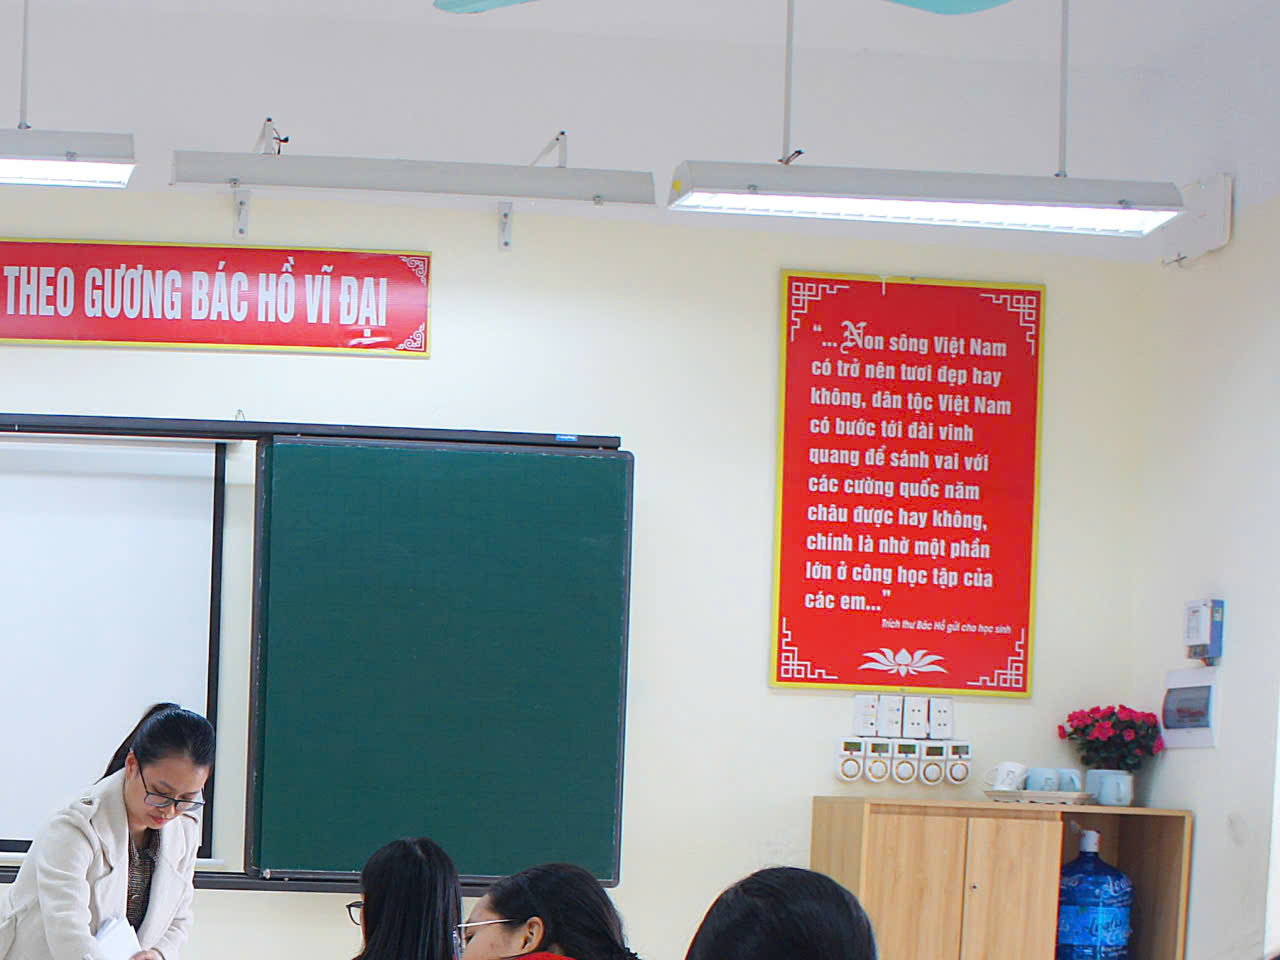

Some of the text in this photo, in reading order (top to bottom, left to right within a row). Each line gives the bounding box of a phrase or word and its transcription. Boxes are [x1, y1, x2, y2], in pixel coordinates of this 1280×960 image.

[3, 266, 74, 317] THEO
[85, 264, 182, 320] GƯƠNG
[192, 261, 248, 321] BÁC
[258, 256, 295, 323] HỒ
[305, 266, 332, 323] VĨ
[339, 276, 387, 337] ĐẠI
[840, 320, 884, 354] Non
[889, 334, 929, 354] sông
[934, 336, 965, 357] Việt
[970, 339, 1007, 357] Nam
[811, 358, 1002, 387] có trở nên tươi đẹp hay
[810, 387, 1011, 415] không, dân tộc Việt Nam
[810, 417, 973, 442] có bước tới đài vinh
[809, 445, 989, 471] quang để sánh vai với
[808, 475, 980, 500] các cường quốc năm
[808, 504, 988, 530] châu được hay không,
[806, 533, 990, 559] chính là nhờ một phần
[805, 561, 993, 589] lớn ở công học tập của
[804, 591, 835, 609] các
